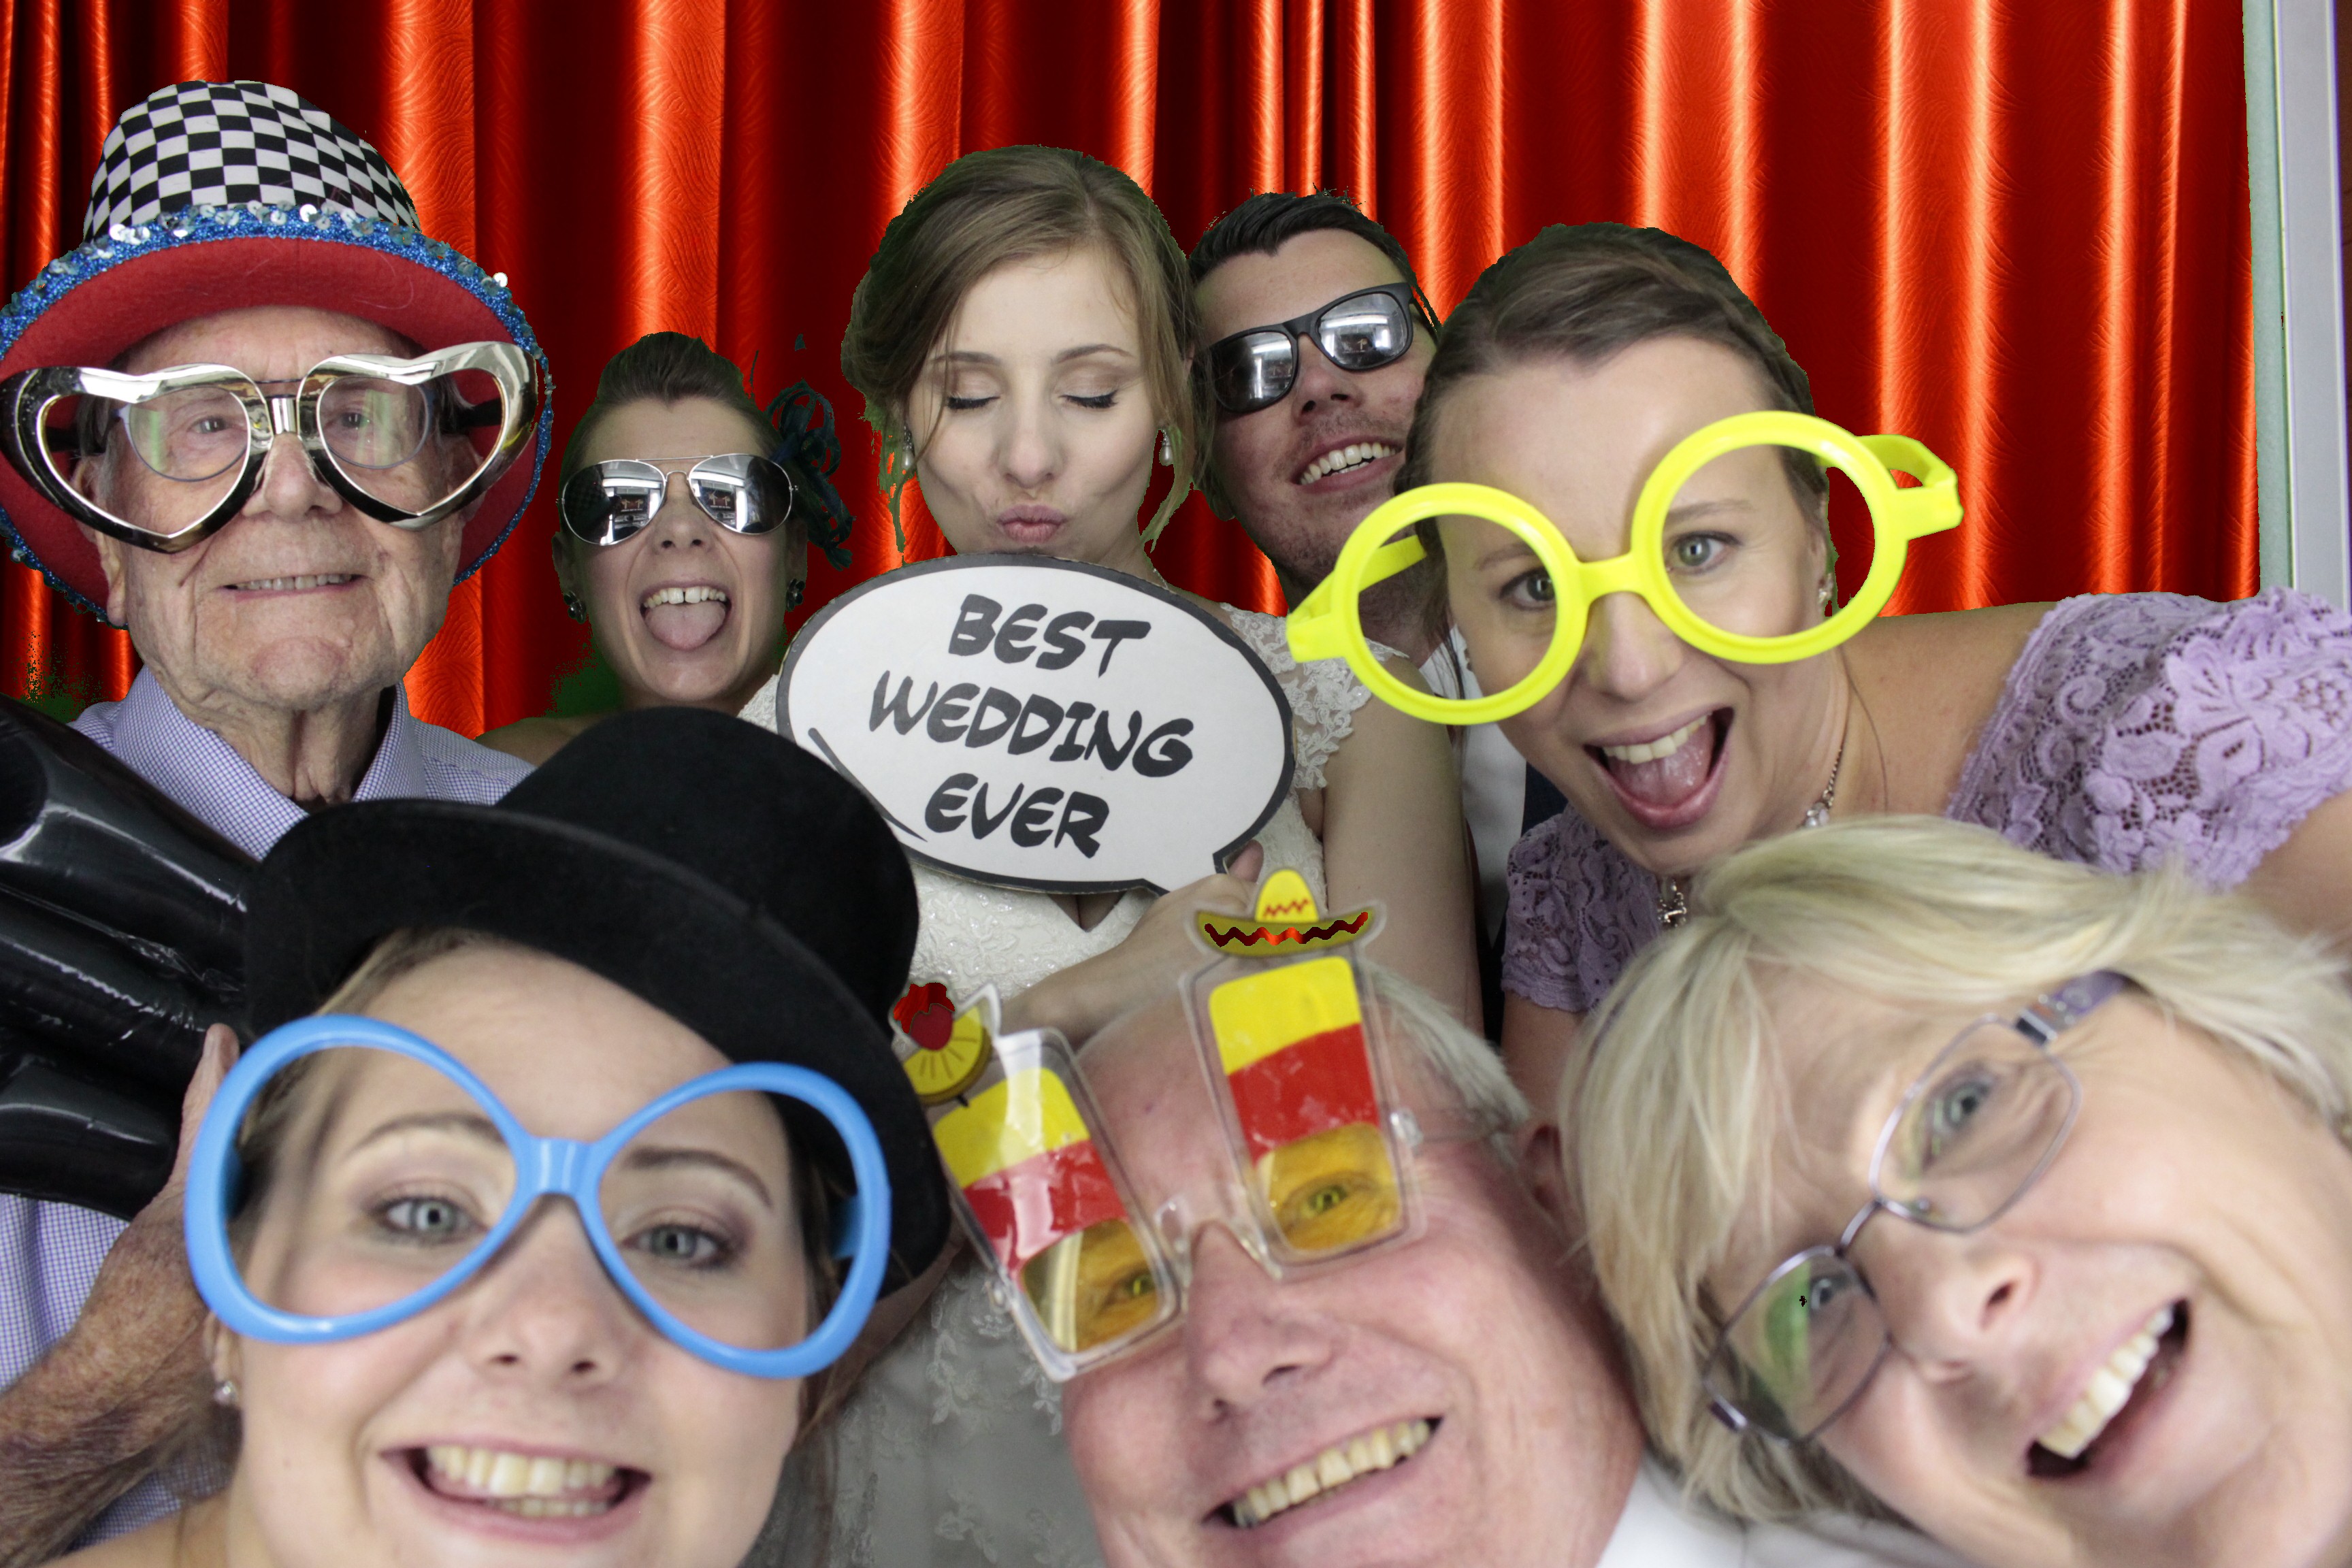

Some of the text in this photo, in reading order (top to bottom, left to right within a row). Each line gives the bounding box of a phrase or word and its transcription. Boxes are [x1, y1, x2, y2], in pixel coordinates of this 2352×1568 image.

[948, 593, 1152, 678] BEST
[868, 670, 1194, 778] WEDDING
[925, 772, 1110, 859] EVER
